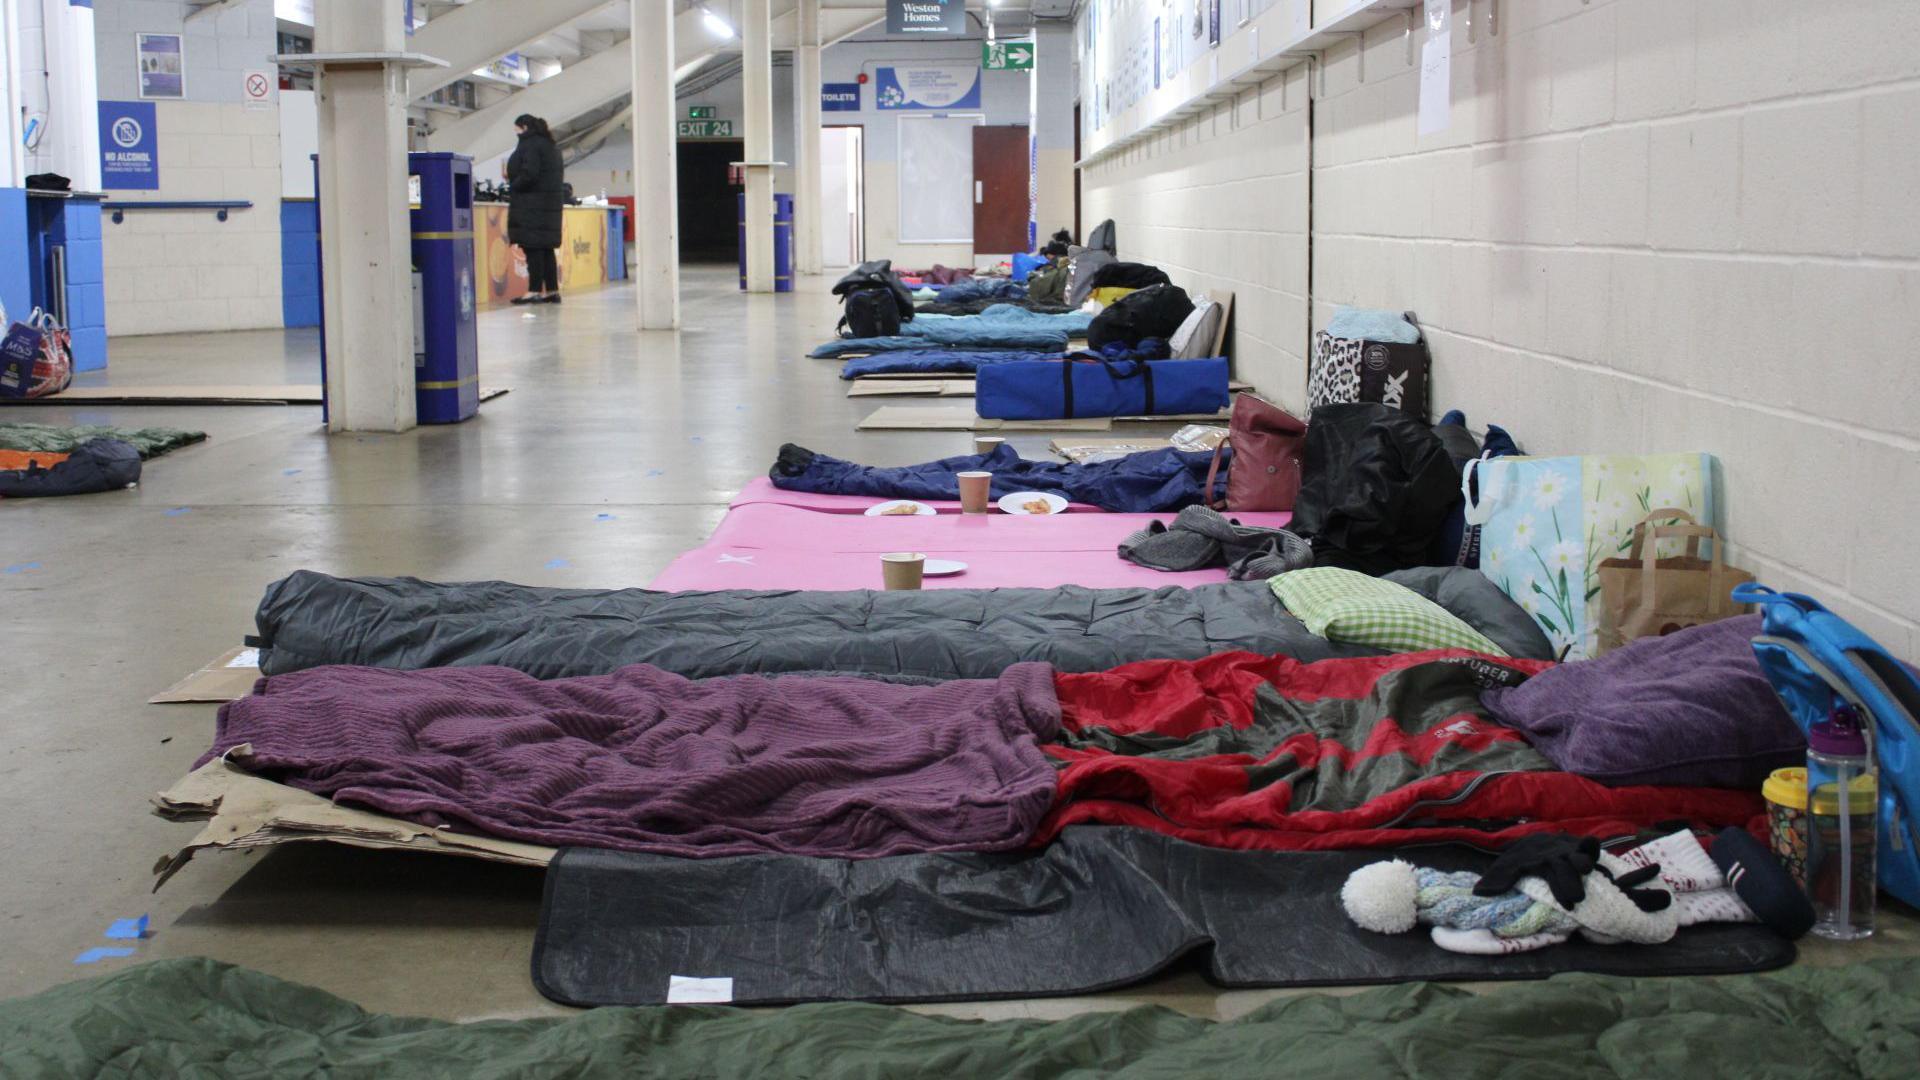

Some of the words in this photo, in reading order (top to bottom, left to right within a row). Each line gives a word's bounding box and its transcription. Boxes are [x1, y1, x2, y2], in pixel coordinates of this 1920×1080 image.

[903, 3, 941, 12] Weston
[904, 12, 940, 22] Homes
[822, 93, 856, 102] TOILETS
[679, 122, 708, 136] EXIT
[713, 122, 730, 136] 24
[105, 152, 116, 161] NO
[117, 152, 151, 161] ALCOHOL
[6, 341, 33, 357] M&S
